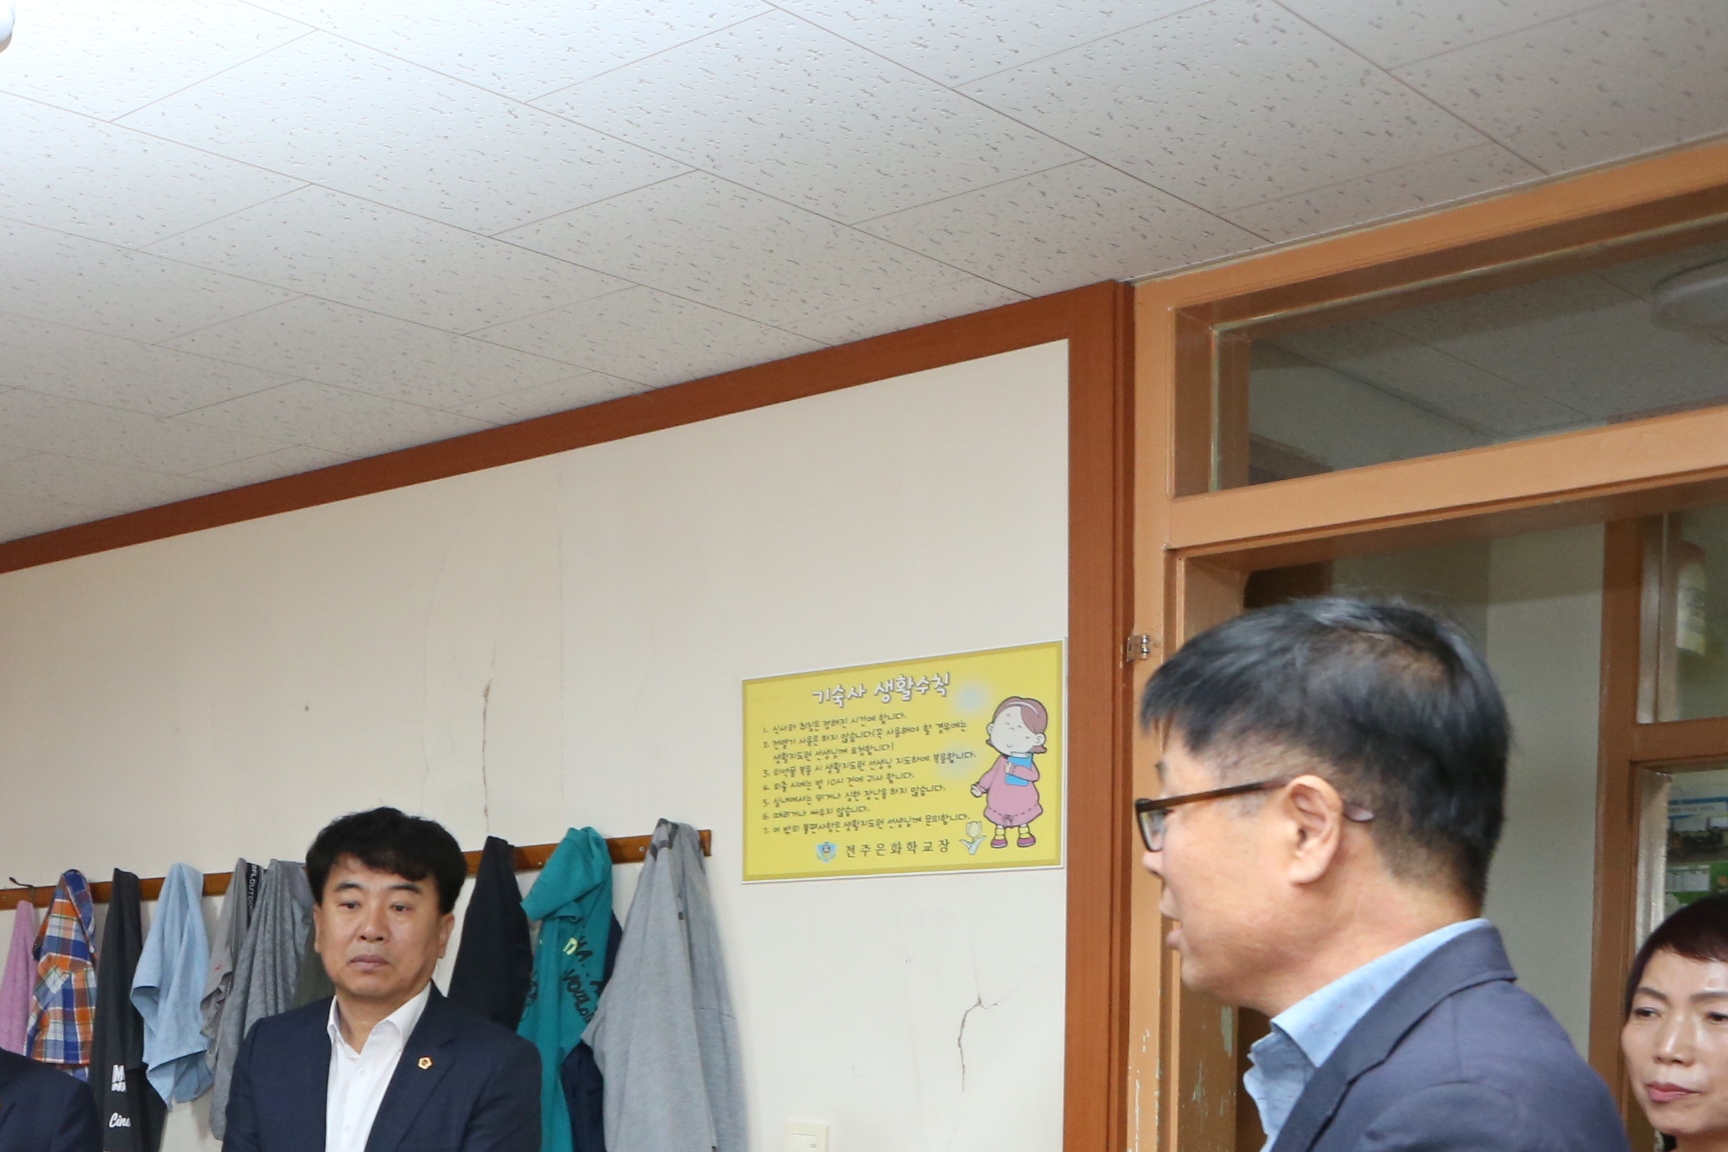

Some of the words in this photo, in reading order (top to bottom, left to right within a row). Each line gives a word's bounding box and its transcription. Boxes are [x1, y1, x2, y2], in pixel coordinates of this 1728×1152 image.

[812, 684, 868, 708] 기숙사
[873, 671, 950, 703] 생활수칙
[773, 723, 796, 734] 식사와
[800, 721, 819, 732] 취침은
[823, 718, 847, 730] 정해진
[850, 714, 876, 727] 시간에
[879, 713, 906, 725] 합니다.
[799, 735, 818, 746] 사용은
[887, 726, 919, 738] 사용해야
[923, 724, 932, 735] 할
[936, 721, 967, 734] 경우에는
[773, 751, 811, 764] 생활지도원
[815, 748, 847, 760] 선생님께
[800, 765, 811, 776] 복용
[825, 761, 865, 774] 생활지도원
[869, 758, 892, 770] 선생님
[896, 755, 929, 765] 지도하에
[933, 751, 976, 764] 복용합니다.
[774, 781, 787, 792] 외출
[791, 781, 811, 790] 시에는
[827, 778, 843, 786] 10시
[847, 776, 863, 787] 전에
[887, 772, 914, 784] 합니다.
[774, 796, 811, 808] 실내에서는
[845, 791, 861, 802] 심한
[864, 788, 886, 800] 장난을
[890, 787, 907, 795] 하지
[910, 784, 946, 797] 않습니다.
[810, 808, 833, 817] 싸우지
[836, 805, 869, 817] 않습니다.
[844, 817, 885, 831] 생활지도원
[887, 816, 922, 829] 선생님께
[925, 813, 970, 827] 문의합니다.
